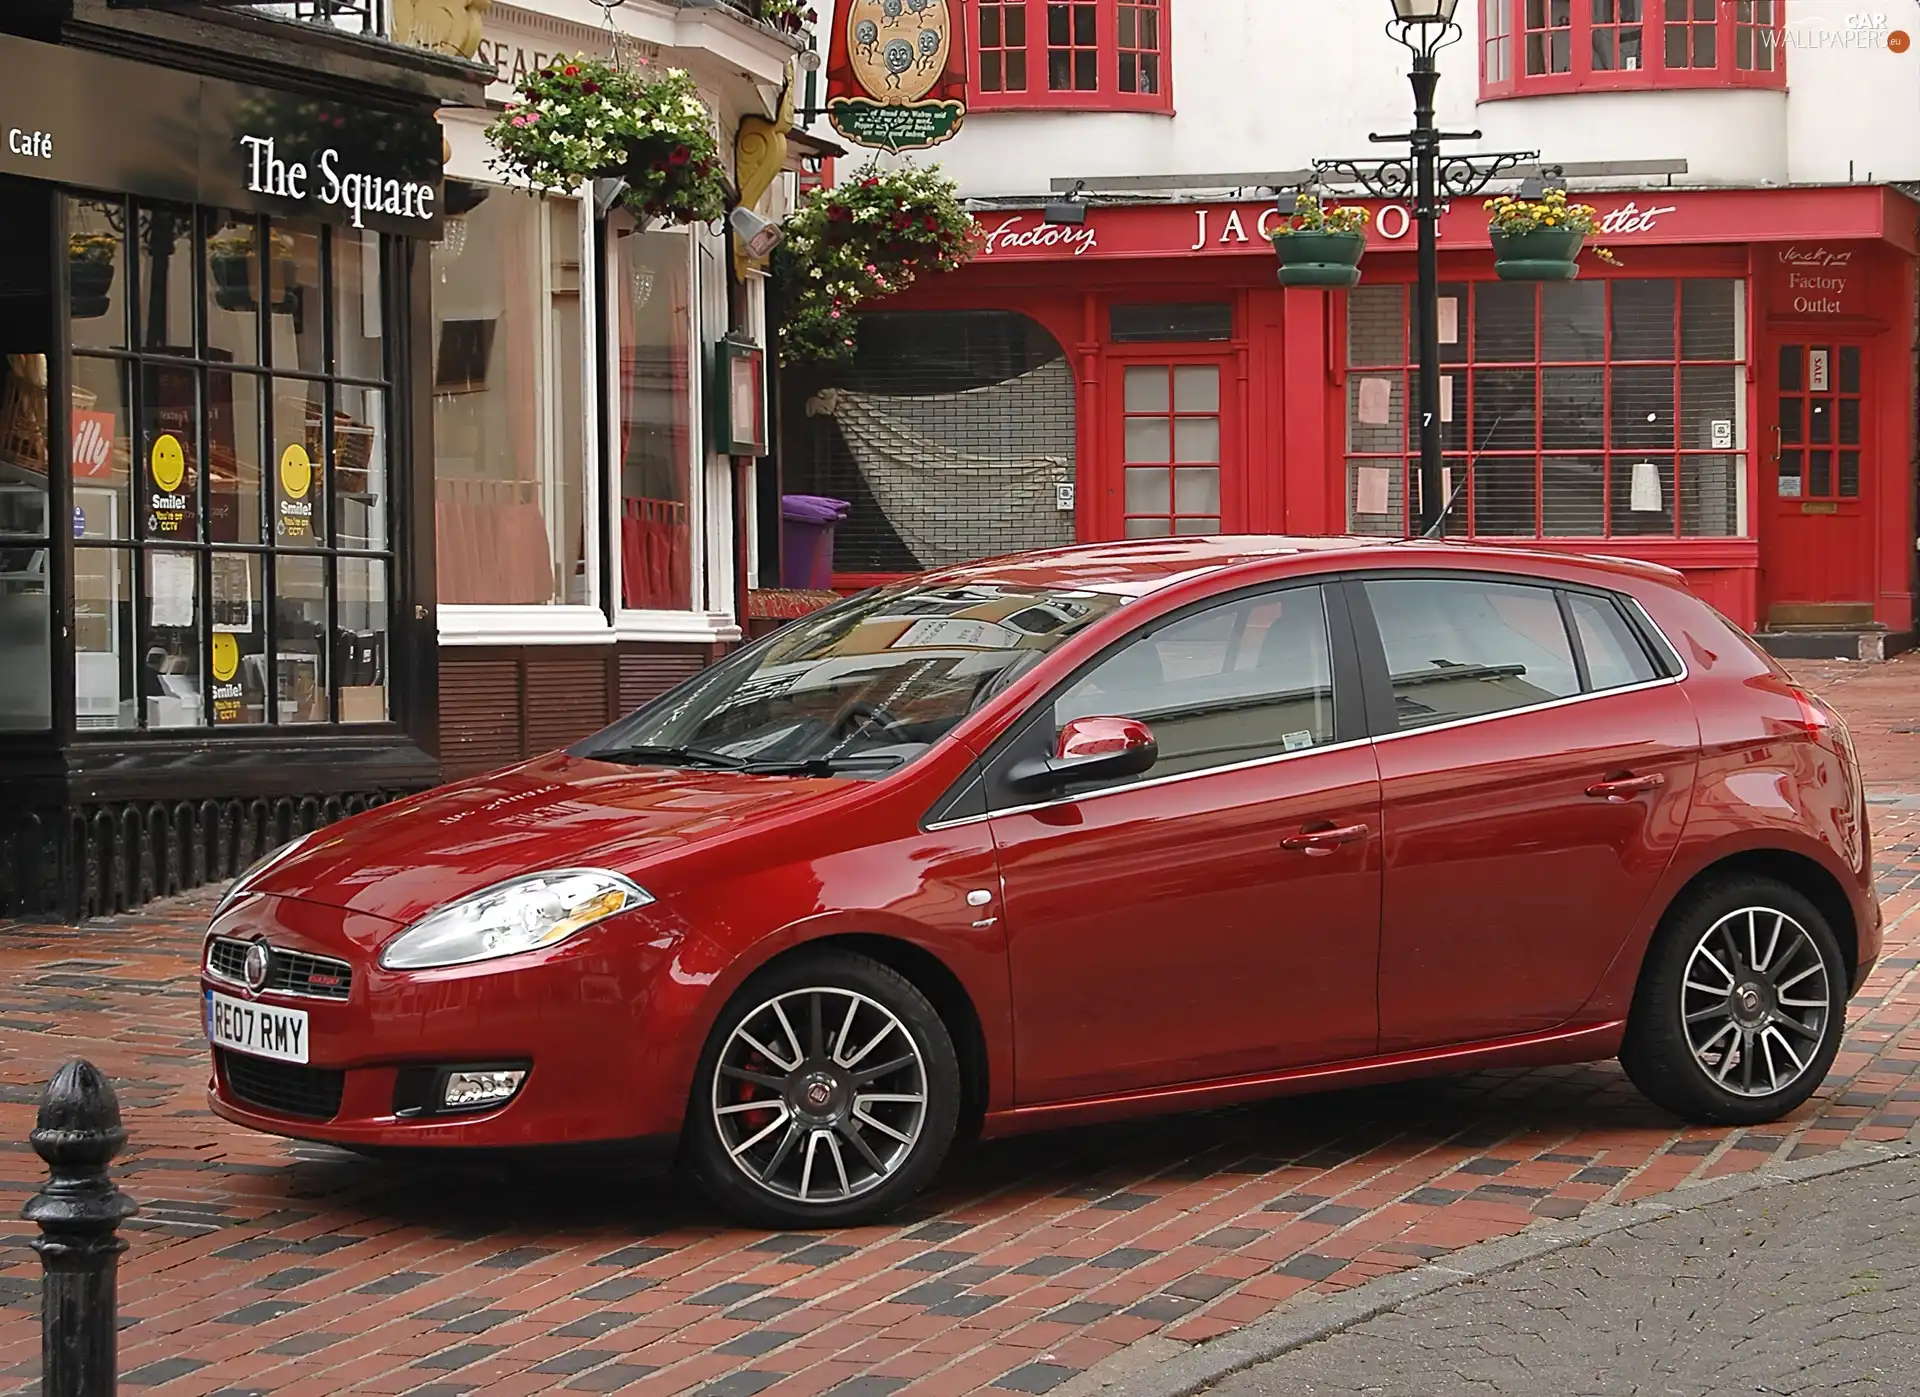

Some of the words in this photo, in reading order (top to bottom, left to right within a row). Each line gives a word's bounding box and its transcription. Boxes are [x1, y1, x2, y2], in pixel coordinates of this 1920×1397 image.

[9, 128, 52, 159] Café
[240, 134, 308, 200] The
[320, 148, 435, 229] Square
[1789, 272, 1846, 294] Factory
[1793, 296, 1841, 314] Outlet
[1813, 355, 1823, 385] SALE
[1423, 412, 1432, 427] 7
[73, 419, 111, 476] illy
[152, 494, 186, 509] Smile!
[280, 500, 313, 516] Smile!
[215, 1001, 255, 1046] RE07
[260, 1012, 303, 1055] RMY
